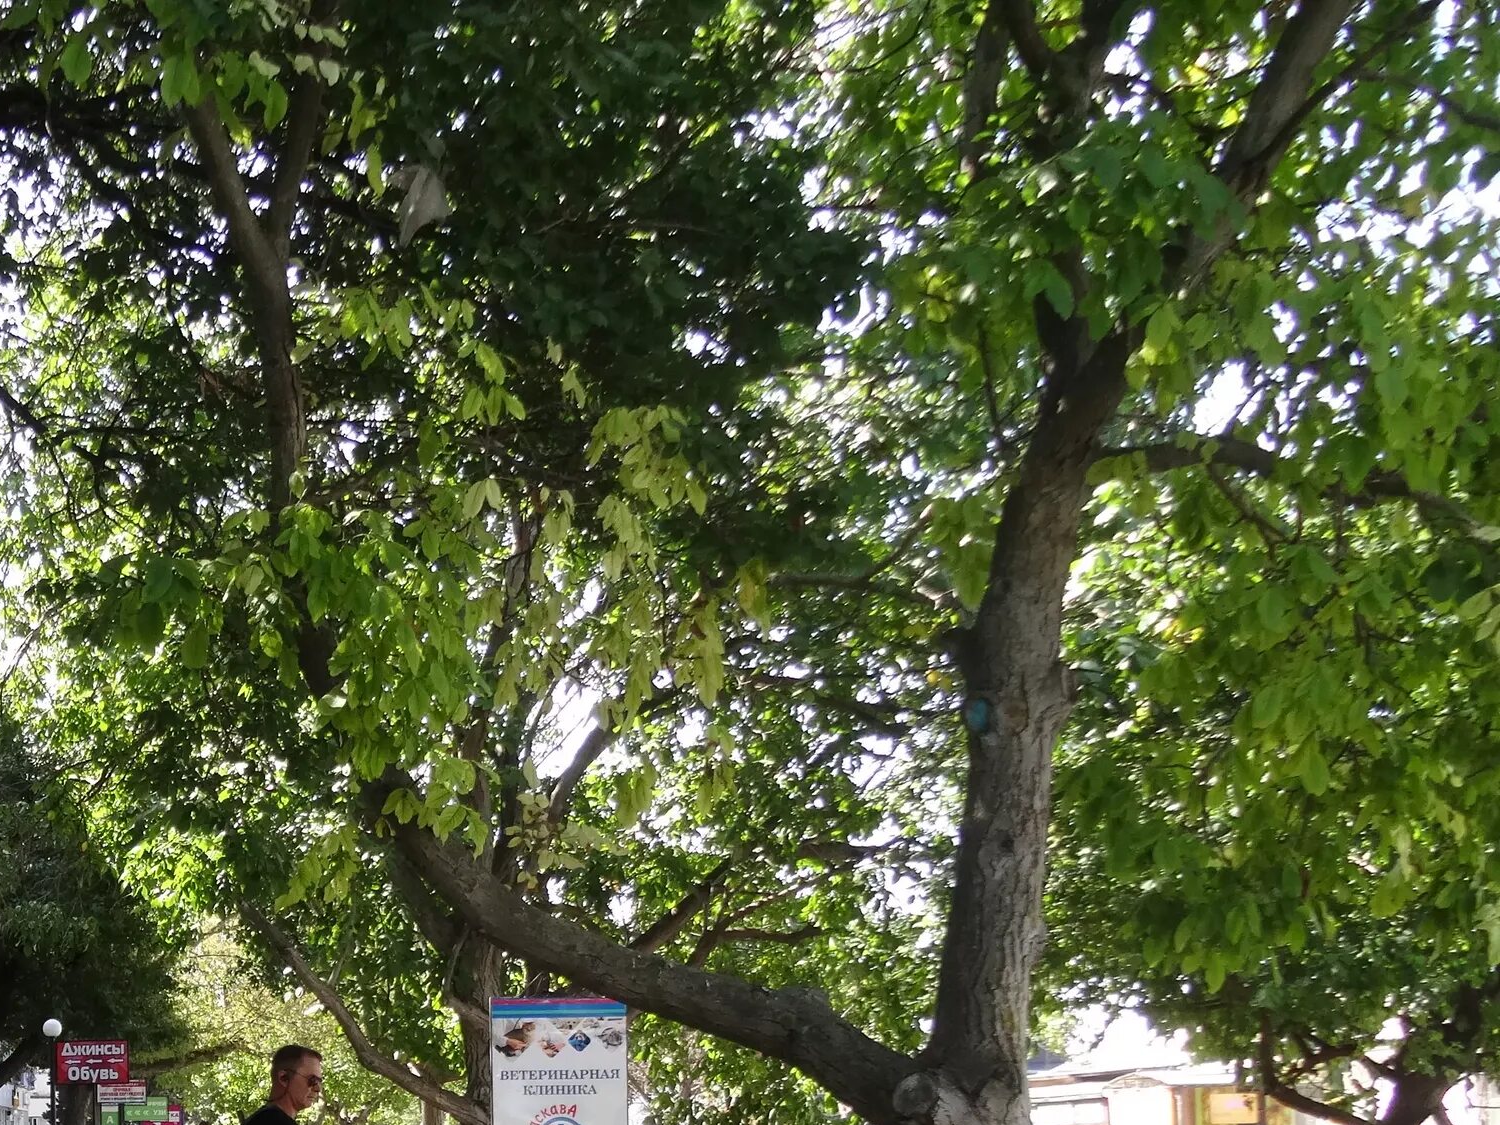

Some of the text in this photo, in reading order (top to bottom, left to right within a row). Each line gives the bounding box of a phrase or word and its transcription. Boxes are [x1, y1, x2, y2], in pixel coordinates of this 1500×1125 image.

[61, 1042, 124, 1056] Джинсы
[67, 1066, 119, 1083] Обувь
[500, 1069, 620, 1081] ВЕТЕРИНАРНАЯ
[523, 1084, 597, 1095] КЛИНИКА
